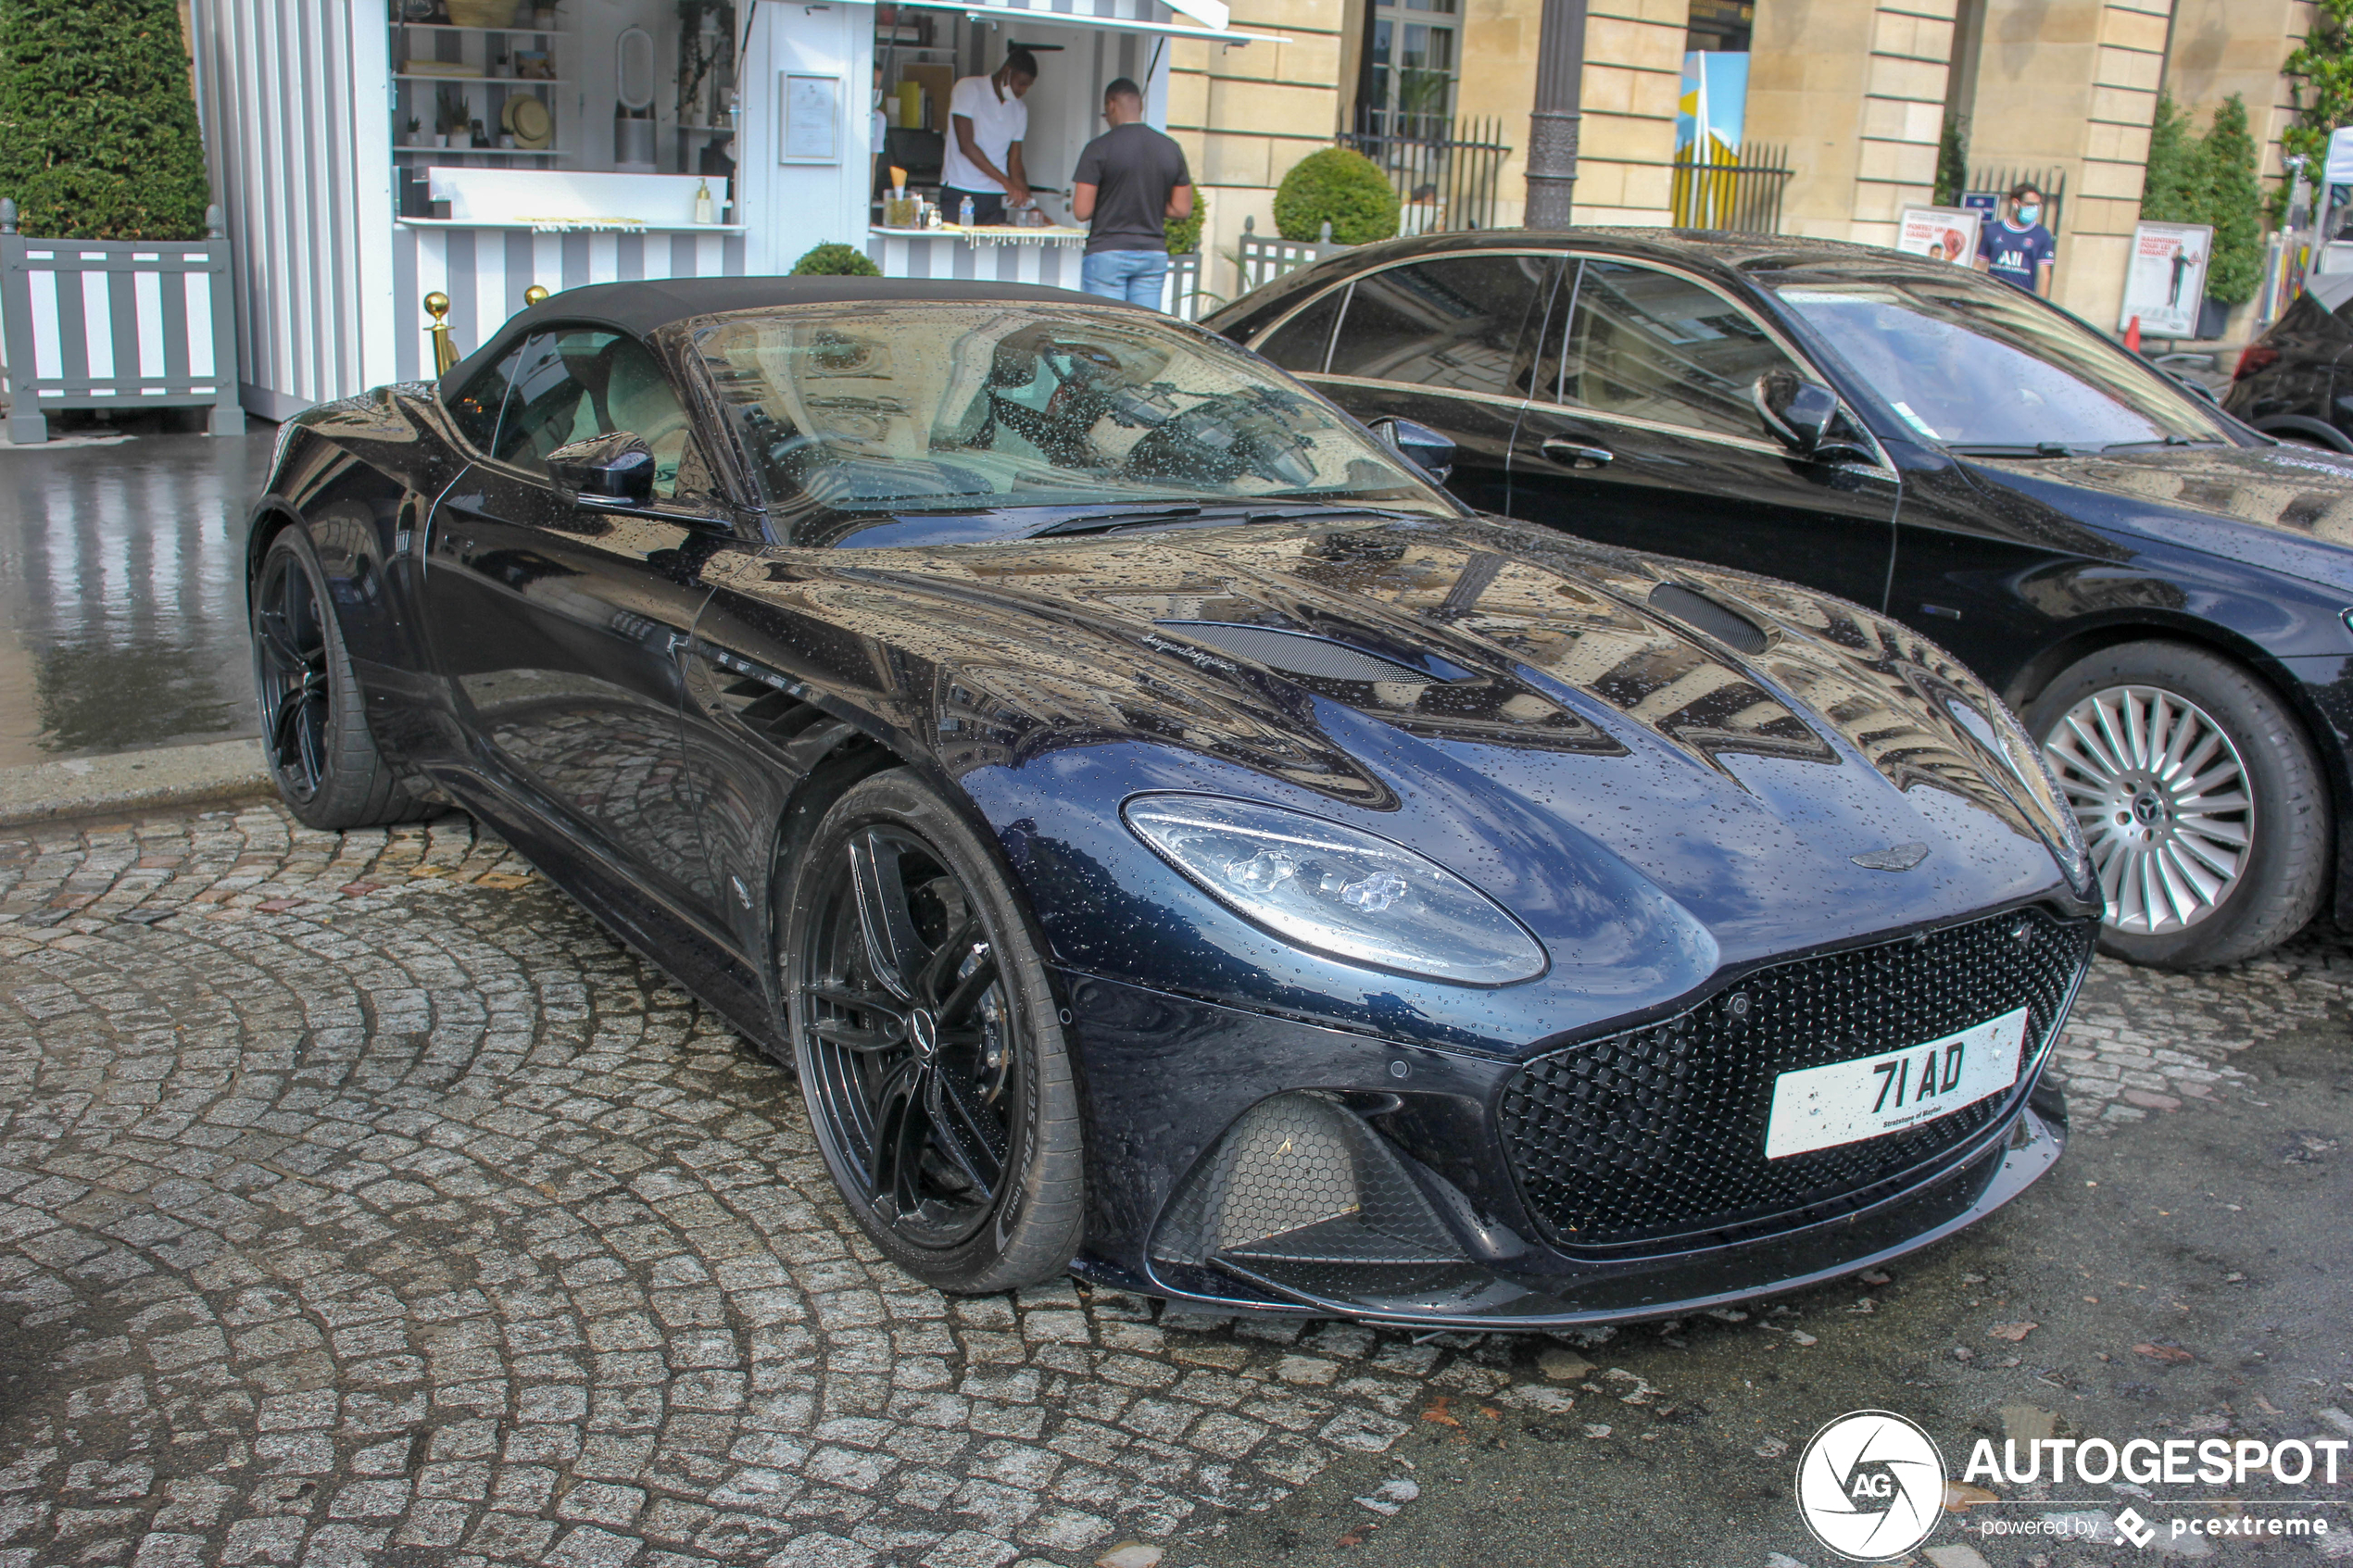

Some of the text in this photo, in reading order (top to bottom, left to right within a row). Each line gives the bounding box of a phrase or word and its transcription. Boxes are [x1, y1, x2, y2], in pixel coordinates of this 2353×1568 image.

[1024, 1033, 1036, 1125] 265/35
[1871, 1041, 1965, 1114] 71 AD
[1882, 1115, 1915, 1128] Stratstone
[1922, 1105, 1943, 1117] Mayfair
[1020, 1127, 1034, 1185] ZR21
